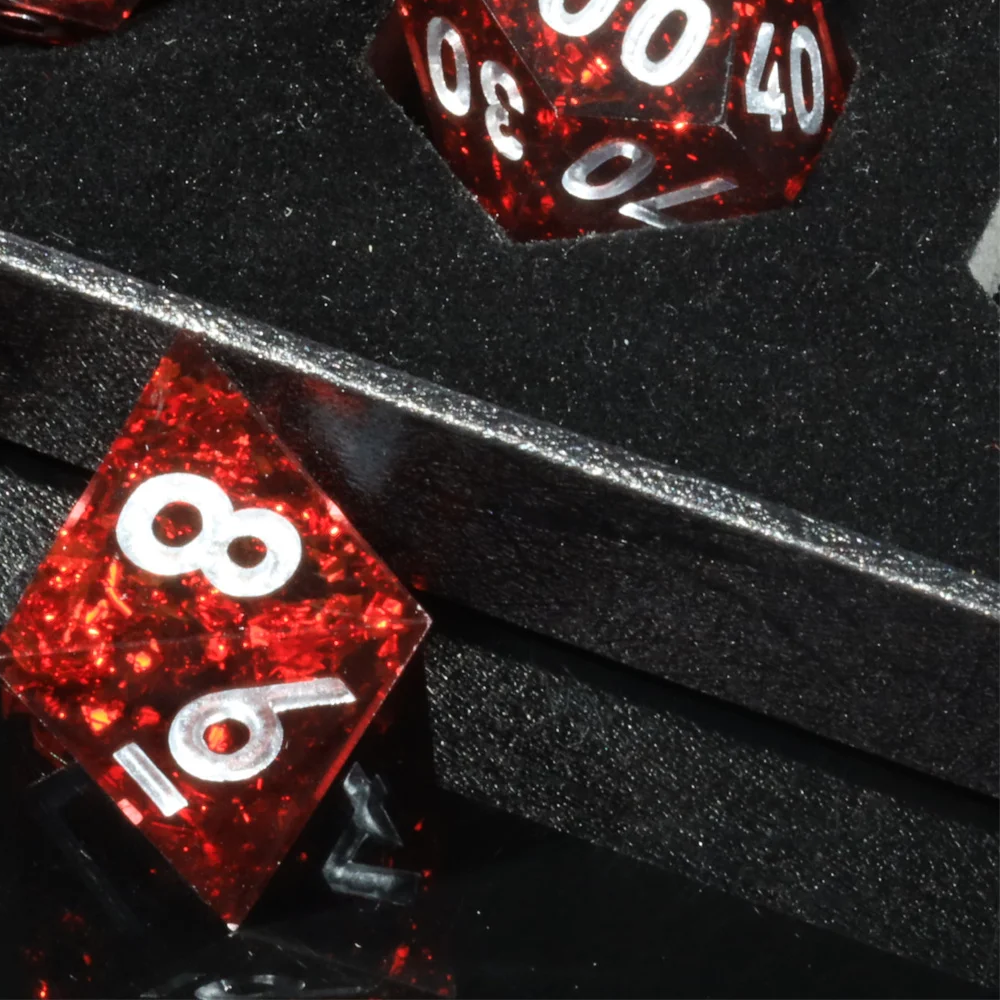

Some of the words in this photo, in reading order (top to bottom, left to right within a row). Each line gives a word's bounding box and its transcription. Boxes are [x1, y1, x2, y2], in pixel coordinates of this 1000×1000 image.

[426, 17, 525, 161] 30
[745, 22, 825, 134] 40
[561, 140, 739, 229] 70
[115, 471, 302, 598] 8
